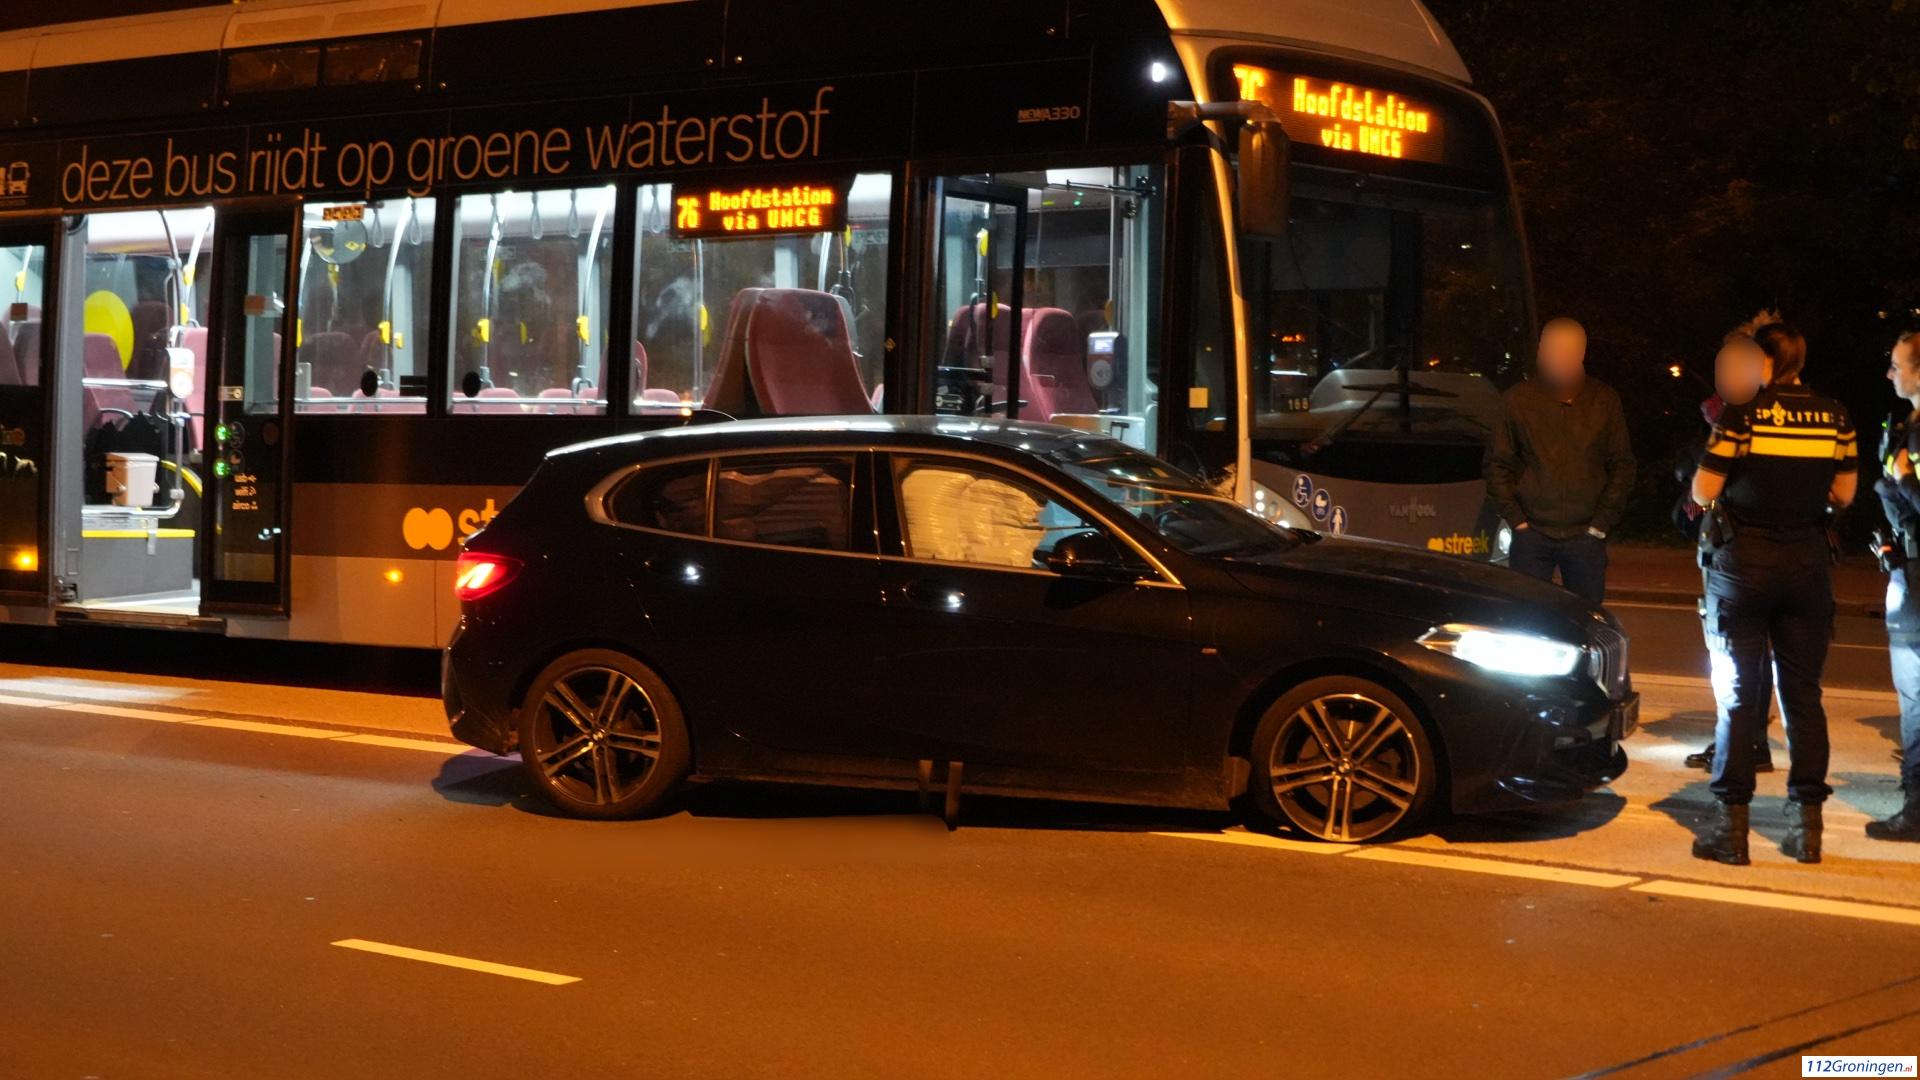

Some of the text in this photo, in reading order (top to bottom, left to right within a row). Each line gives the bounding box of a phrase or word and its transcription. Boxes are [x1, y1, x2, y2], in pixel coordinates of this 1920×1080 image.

[1293, 78, 1428, 133] Hoofdstation
[62, 86, 835, 203] deze bus rijdt op groene waterstof
[1320, 123, 1402, 158] via UMCG
[677, 186, 833, 229] 76 Hoofdstation
[722, 206, 823, 231] via UMCG
